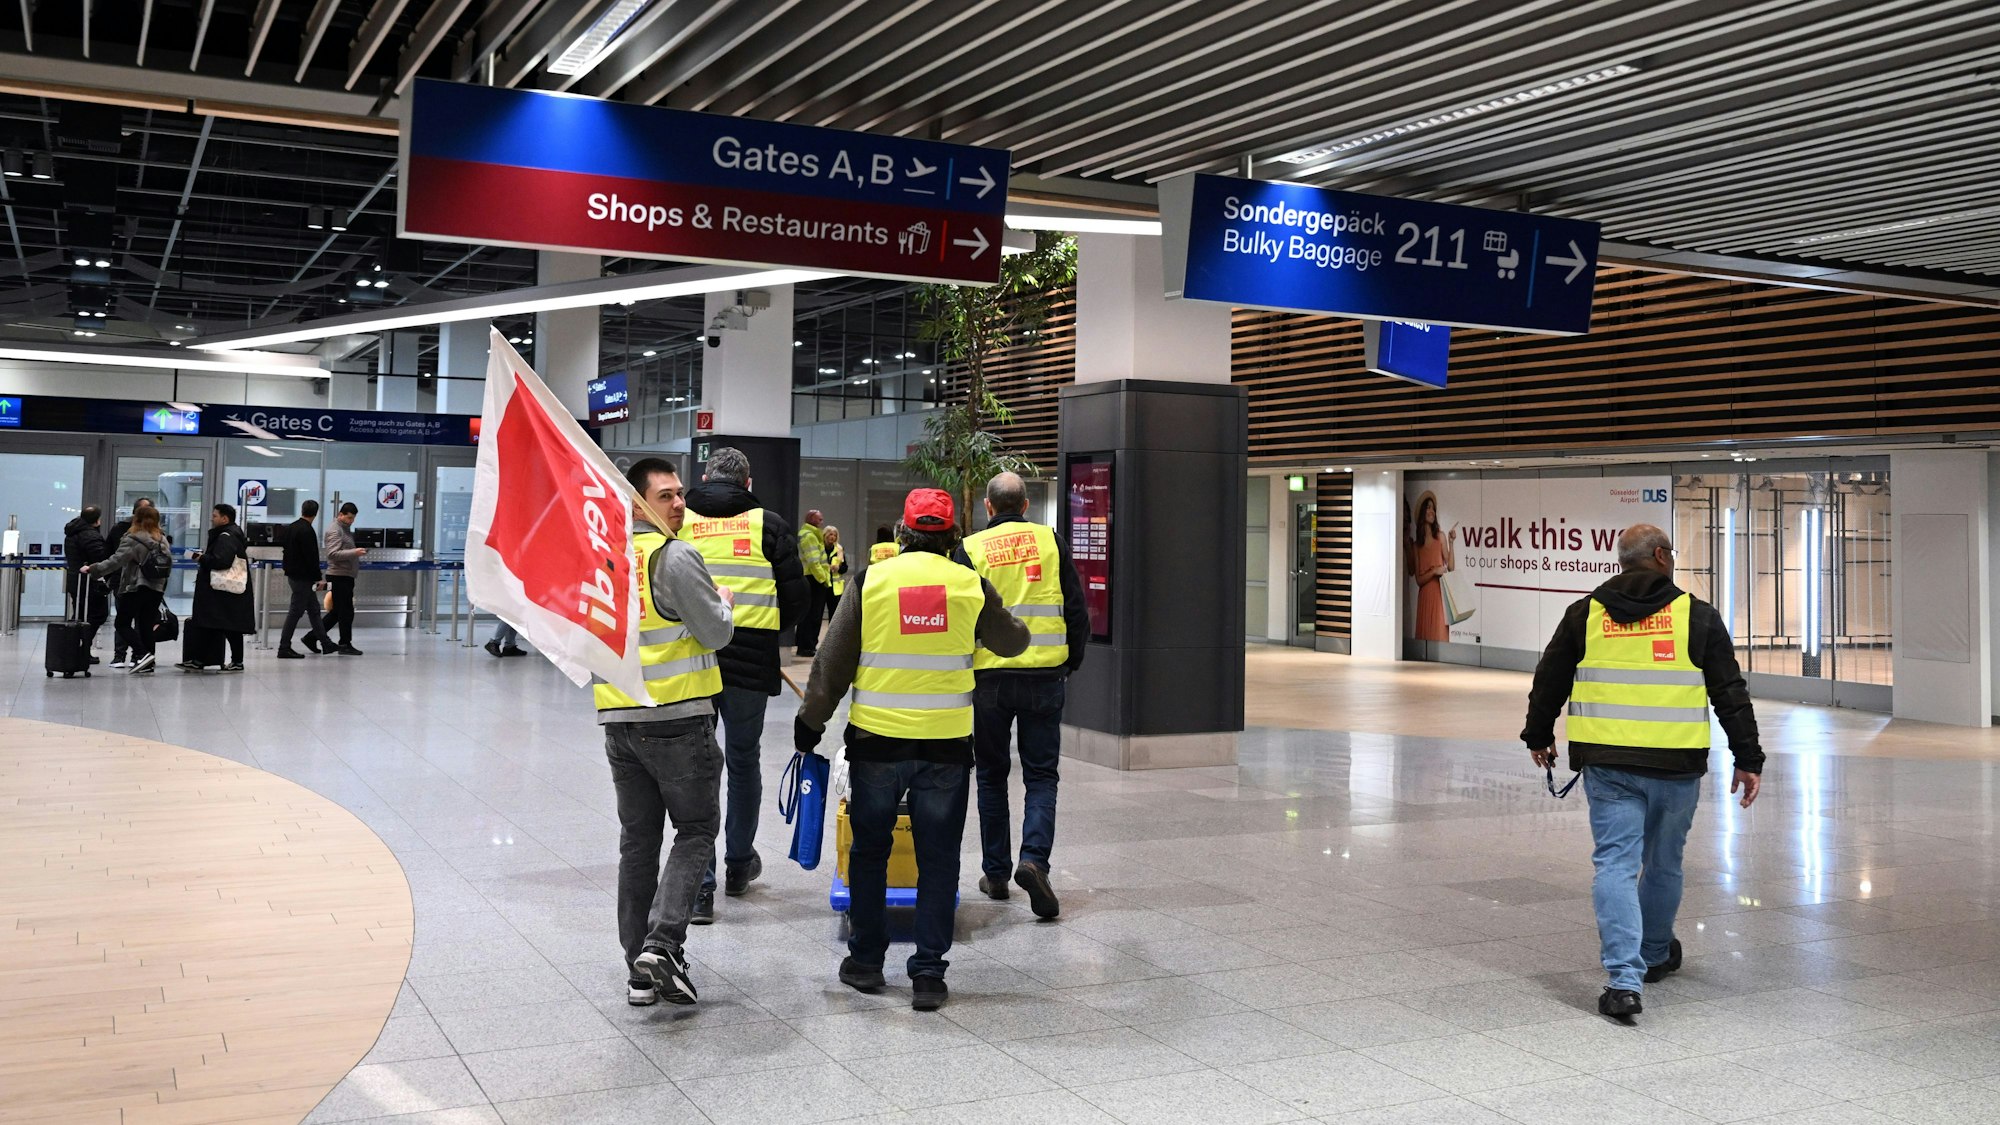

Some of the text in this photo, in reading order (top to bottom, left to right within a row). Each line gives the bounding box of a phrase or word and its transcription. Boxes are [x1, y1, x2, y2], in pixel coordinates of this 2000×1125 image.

[712, 136, 894, 188] Gates A,B
[587, 193, 888, 245] Shops & Restaurants
[1223, 196, 1386, 237] Sondergepäck
[1223, 228, 1382, 271] Bulky Baggage
[1394, 222, 1468, 270] 211
[250, 412, 334, 431] Gates C
[349, 418, 376, 427] Zugang
[405, 420, 426, 428] Gates
[1642, 489, 1667, 503] DUS
[692, 519, 750, 535] GEHT MEHR
[1462, 517, 1522, 549] walk
[1529, 518, 1583, 551] this
[984, 534, 1037, 552] ZUSAMMEN
[986, 545, 1039, 564] GEHT MEHR
[1465, 554, 1621, 574] to our shops & restauran
[902, 613, 945, 627] ver.di
[1638, 615, 1673, 630] MEHR
